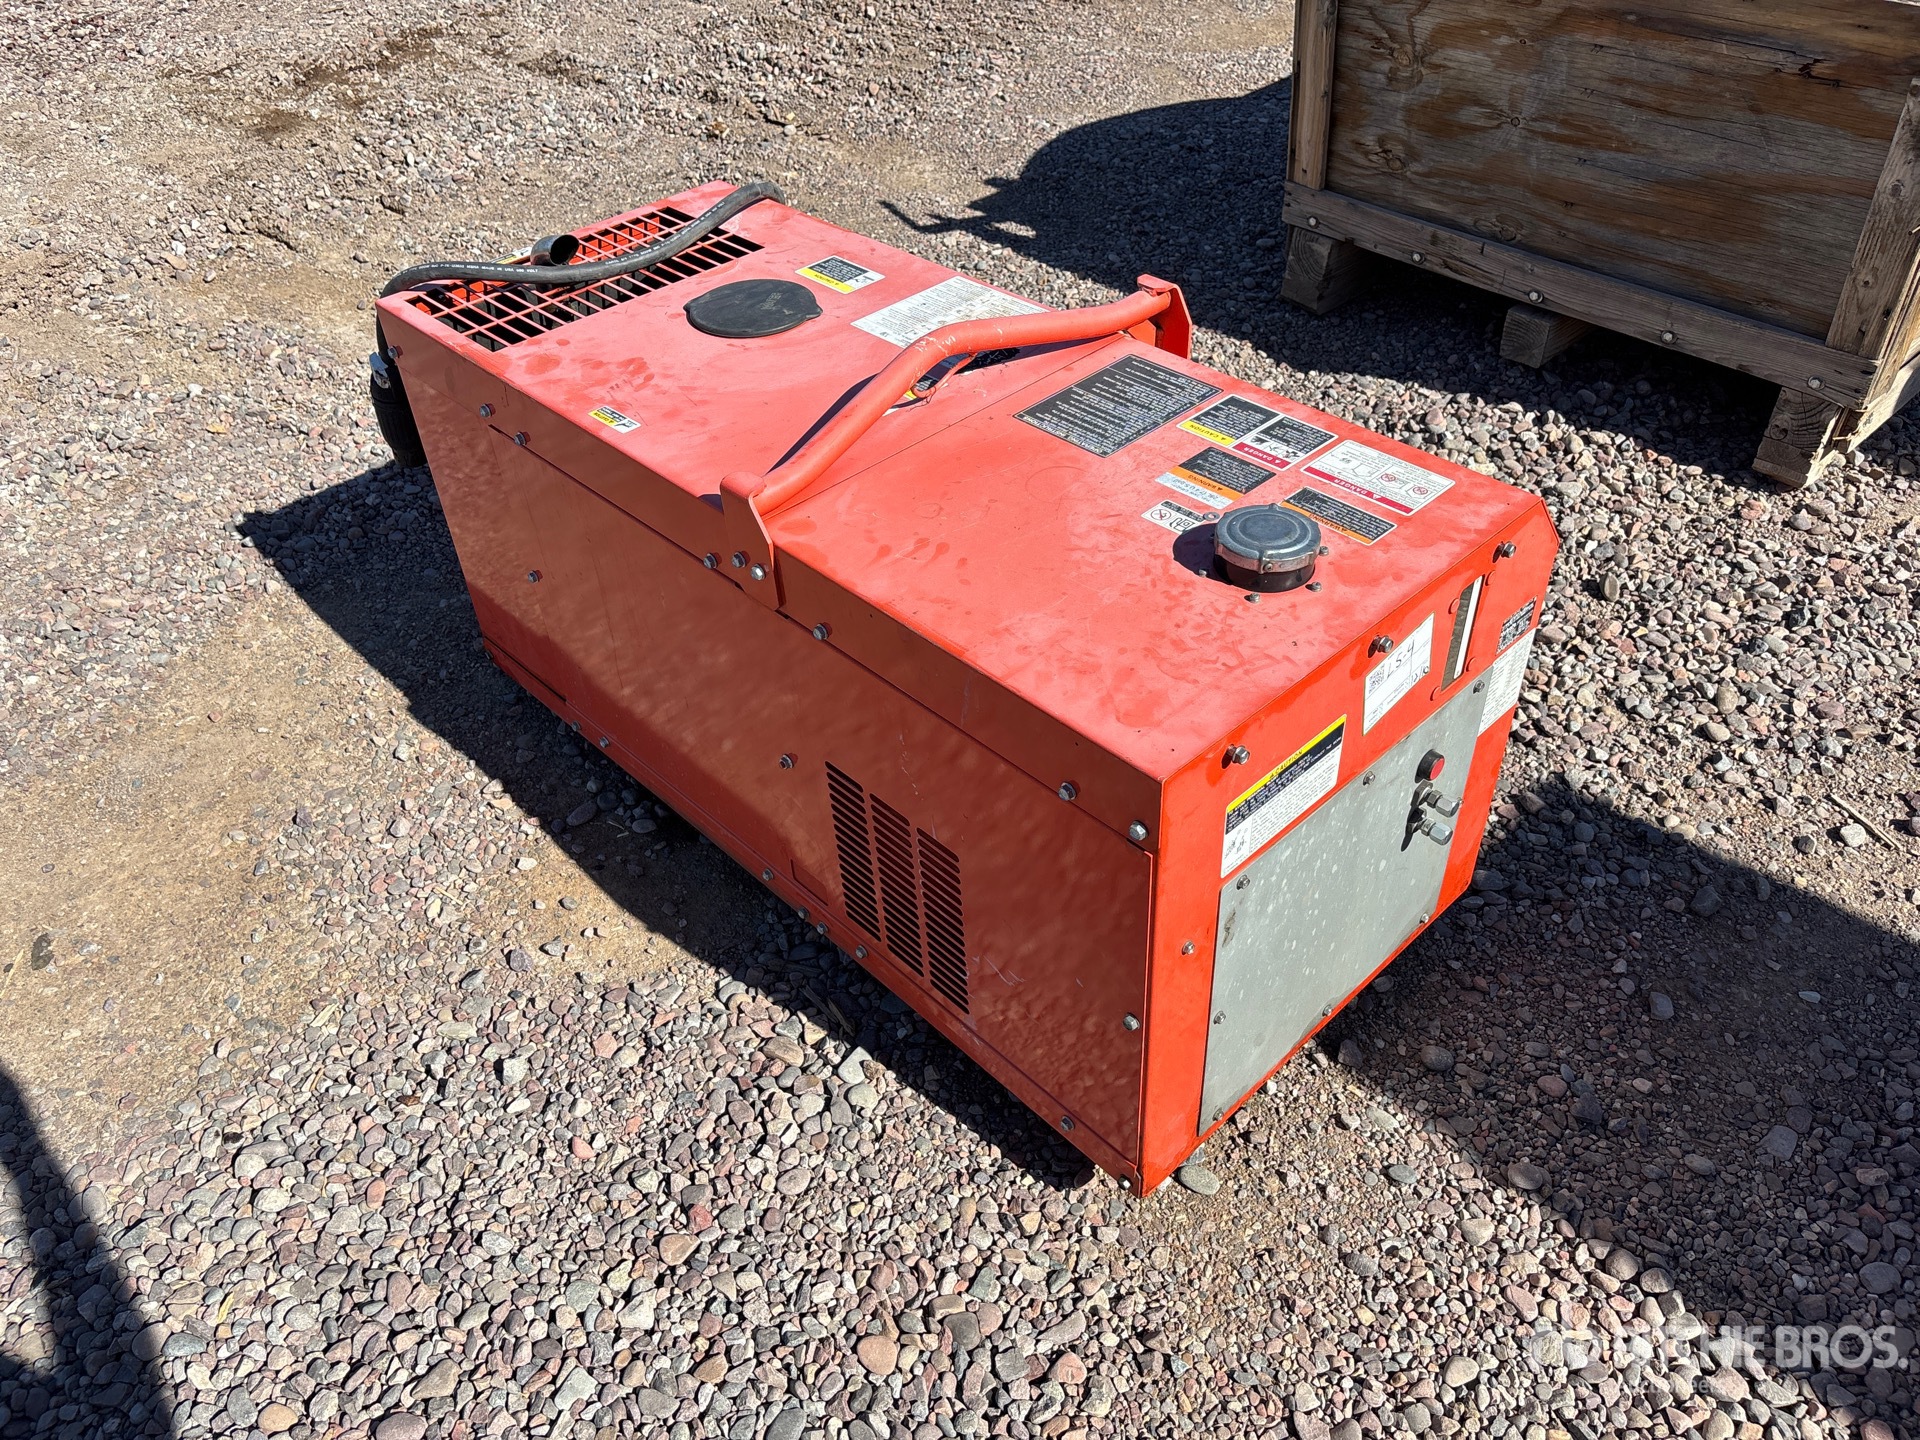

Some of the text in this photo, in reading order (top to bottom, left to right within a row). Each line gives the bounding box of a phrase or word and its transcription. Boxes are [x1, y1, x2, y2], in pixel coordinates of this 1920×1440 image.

[1022, 416, 1067, 436] INSTRUCTIONS
[1187, 425, 1220, 437] CAUTION
[1243, 446, 1273, 460] DANGER
[1186, 475, 1217, 488] WARNING
[1333, 478, 1368, 494] DANGER
[1276, 749, 1302, 774] CAUTION
